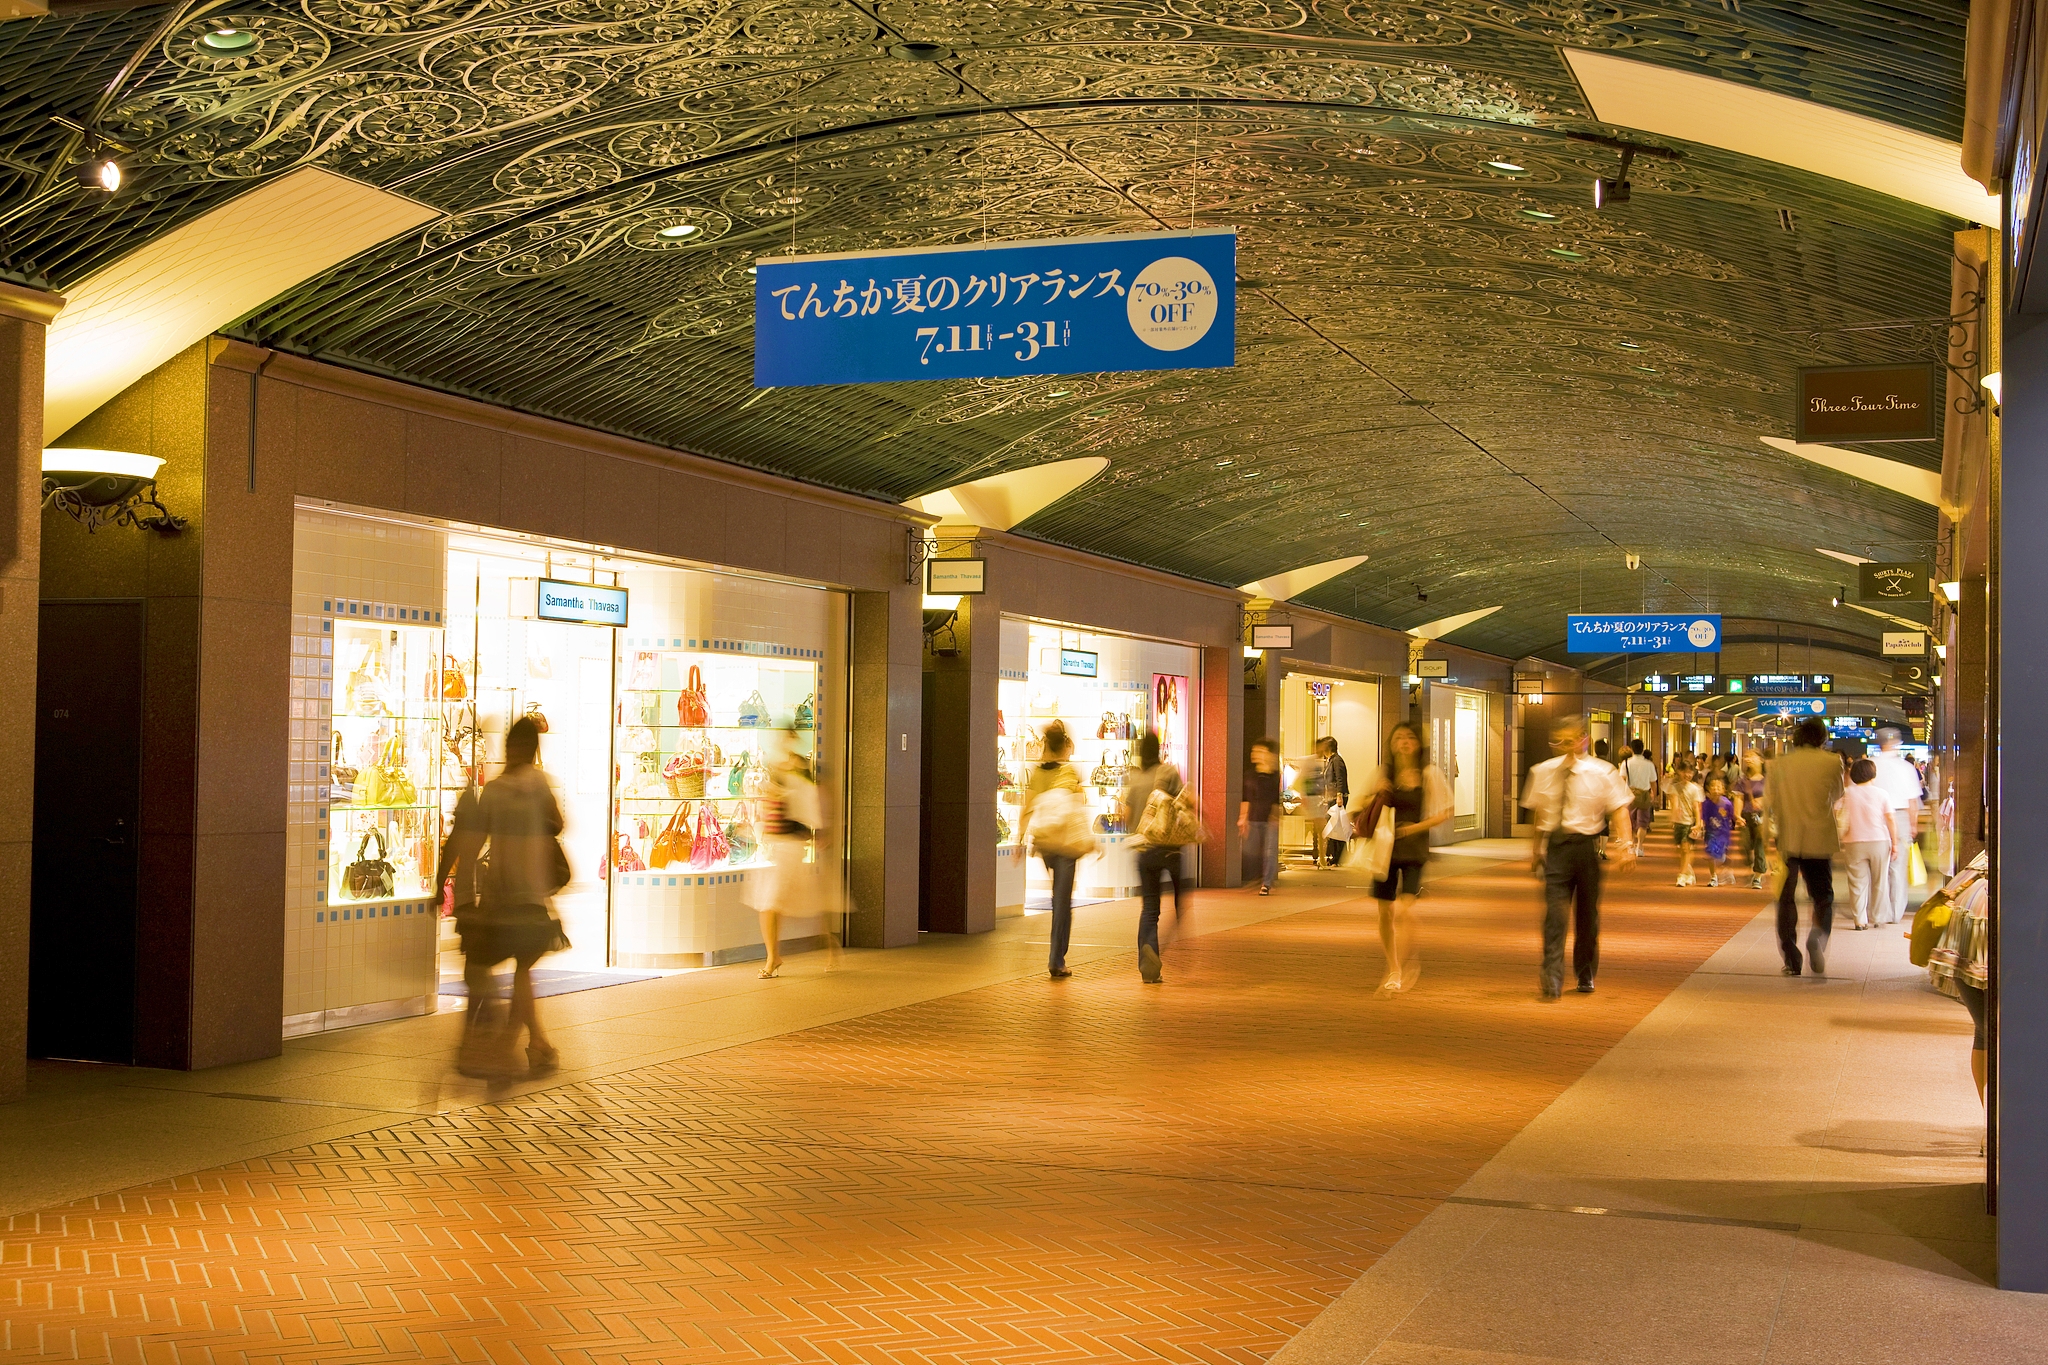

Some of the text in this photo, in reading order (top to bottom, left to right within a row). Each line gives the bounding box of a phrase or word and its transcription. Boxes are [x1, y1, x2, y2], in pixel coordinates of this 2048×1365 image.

[771, 268, 1125, 321] てんちか夏のクリアランス
[1150, 303, 1195, 323] OFF
[915, 325, 984, 365] 7.11
[1810, 394, 1919, 412] Three Four Time
[545, 594, 619, 612] Samantha Thavasa
[1573, 621, 1688, 633] てんちか夏のクリアランス
[1312, 682, 1330, 696] SOUP
[53, 709, 69, 718] 074
